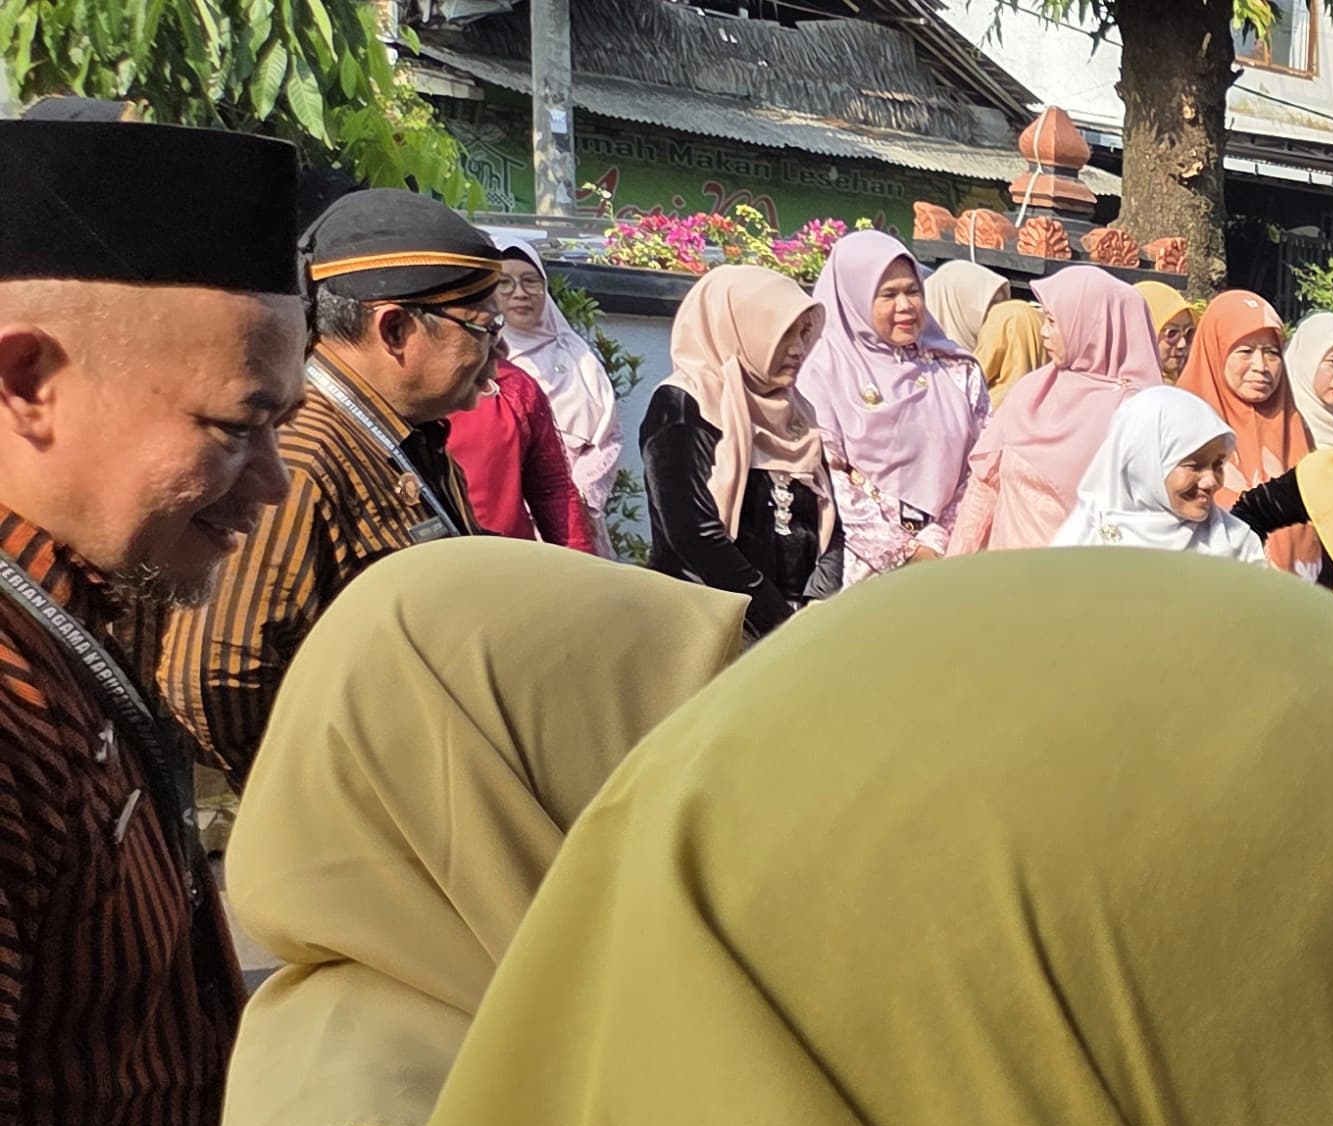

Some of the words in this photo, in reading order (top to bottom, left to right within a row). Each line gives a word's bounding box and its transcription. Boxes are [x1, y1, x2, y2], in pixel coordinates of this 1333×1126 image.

[575, 134, 656, 162] mah
[668, 141, 772, 179] Makan
[782, 159, 905, 199] Lesehan
[43, 602, 92, 655] AGAMA
